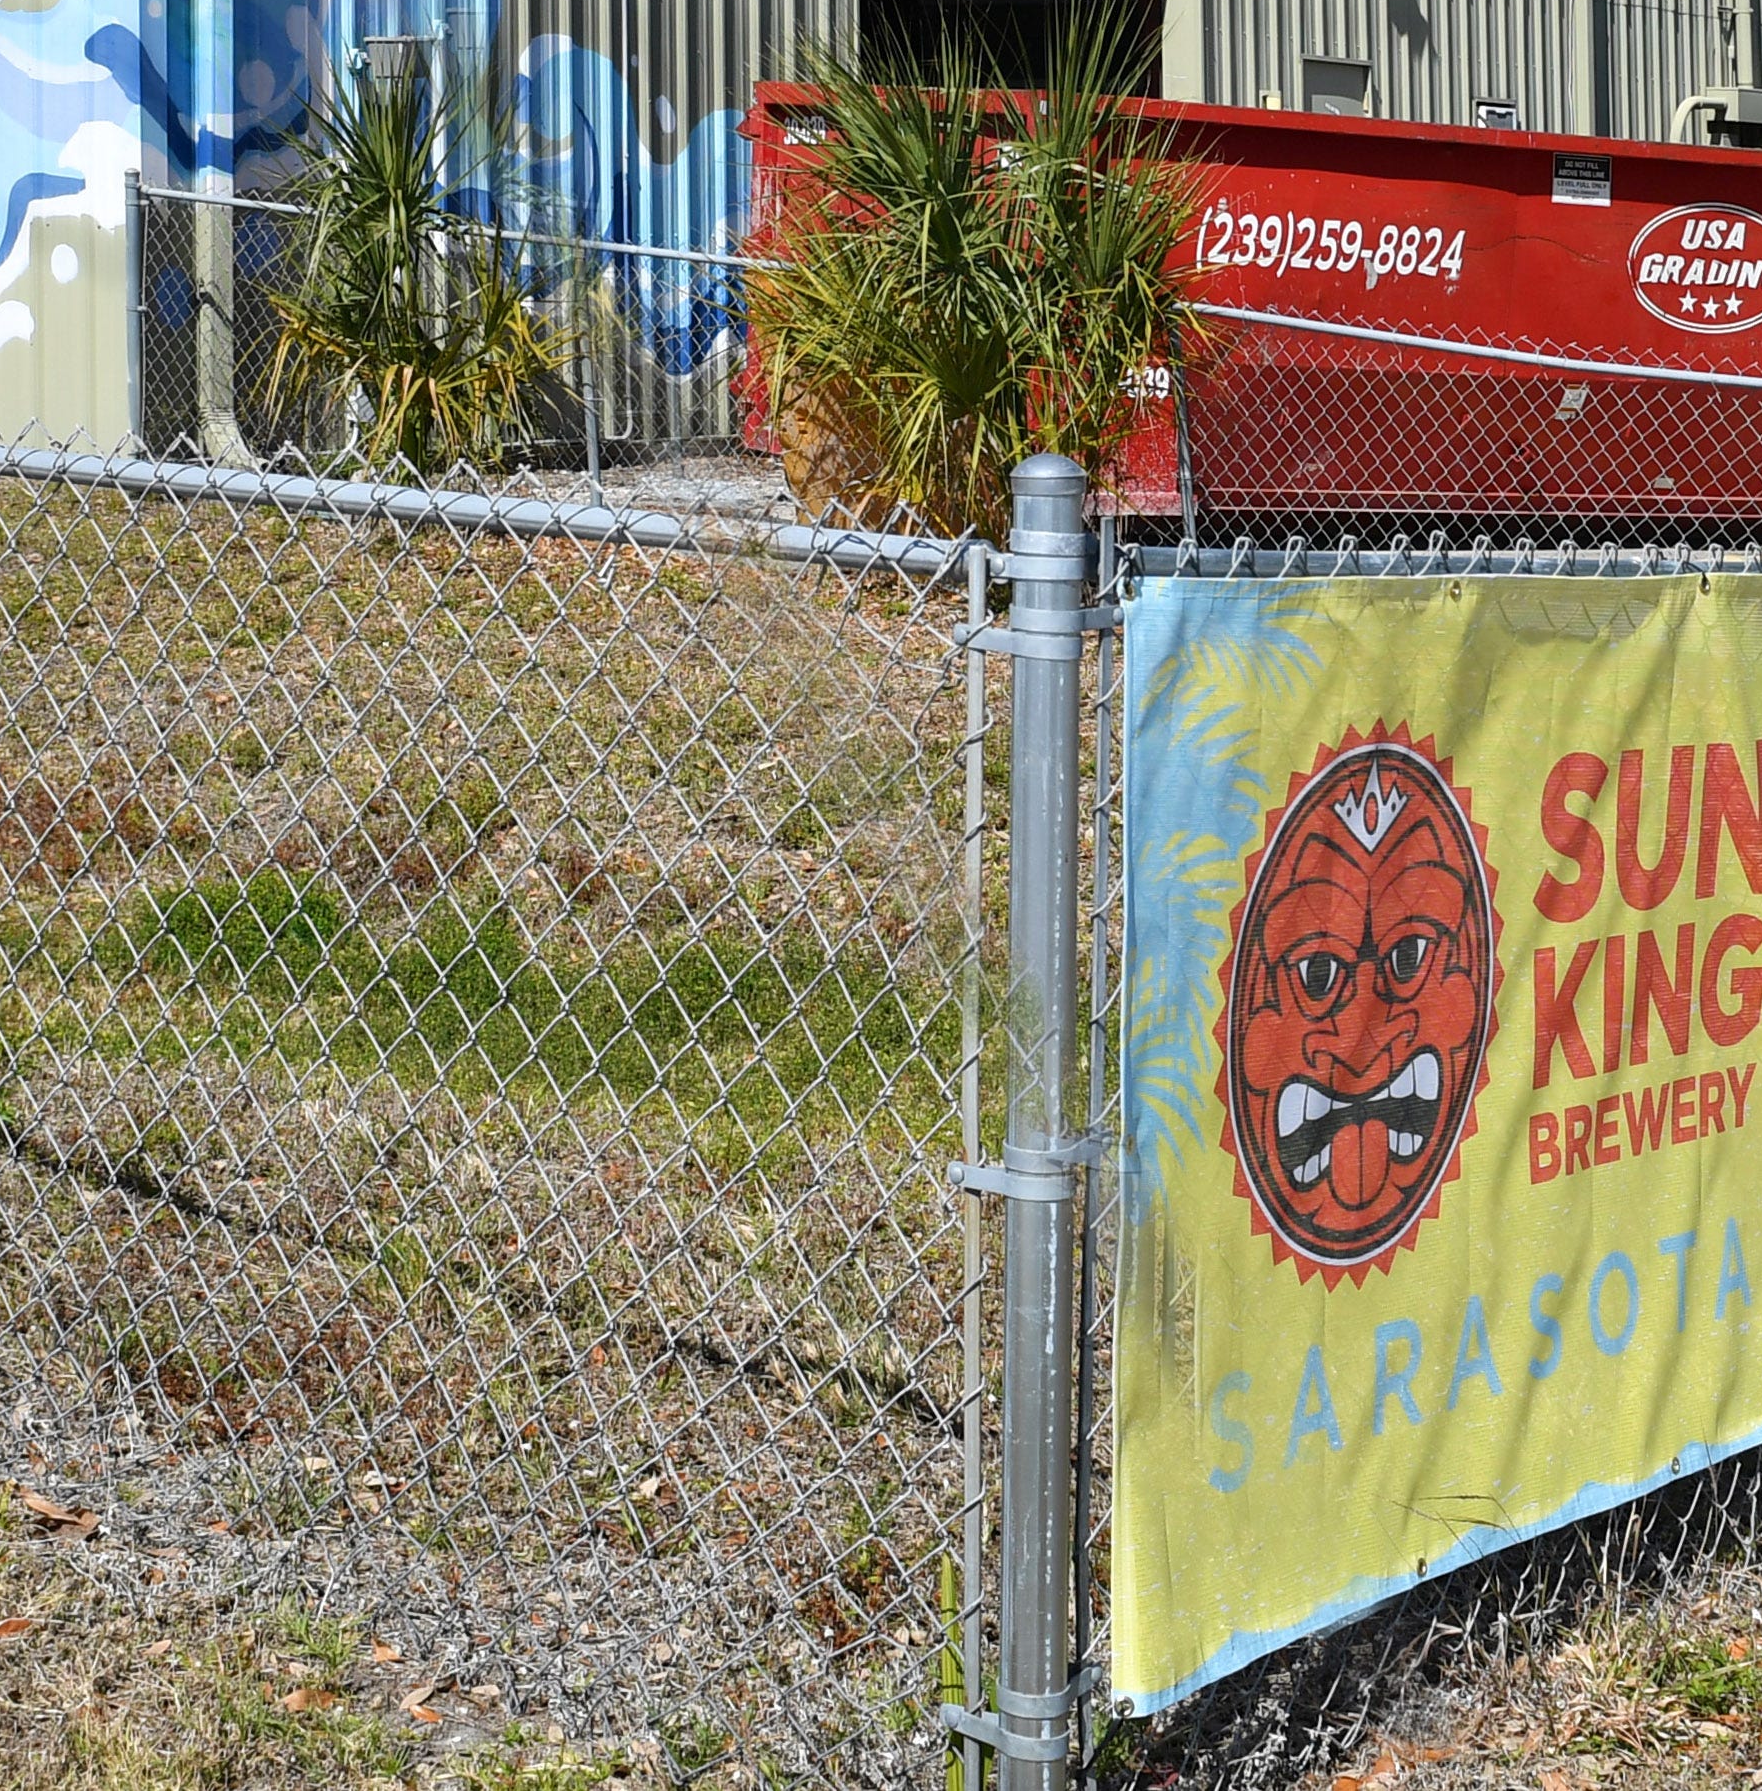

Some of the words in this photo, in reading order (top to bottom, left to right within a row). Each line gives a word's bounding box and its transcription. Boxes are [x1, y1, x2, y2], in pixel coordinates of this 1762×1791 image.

[1196, 204, 1466, 280] (239)259-8824
[1680, 219, 1746, 251] USA
[1529, 1062, 1757, 1186] BREWERY
[1208, 1215, 1753, 1493] SARASOTA
